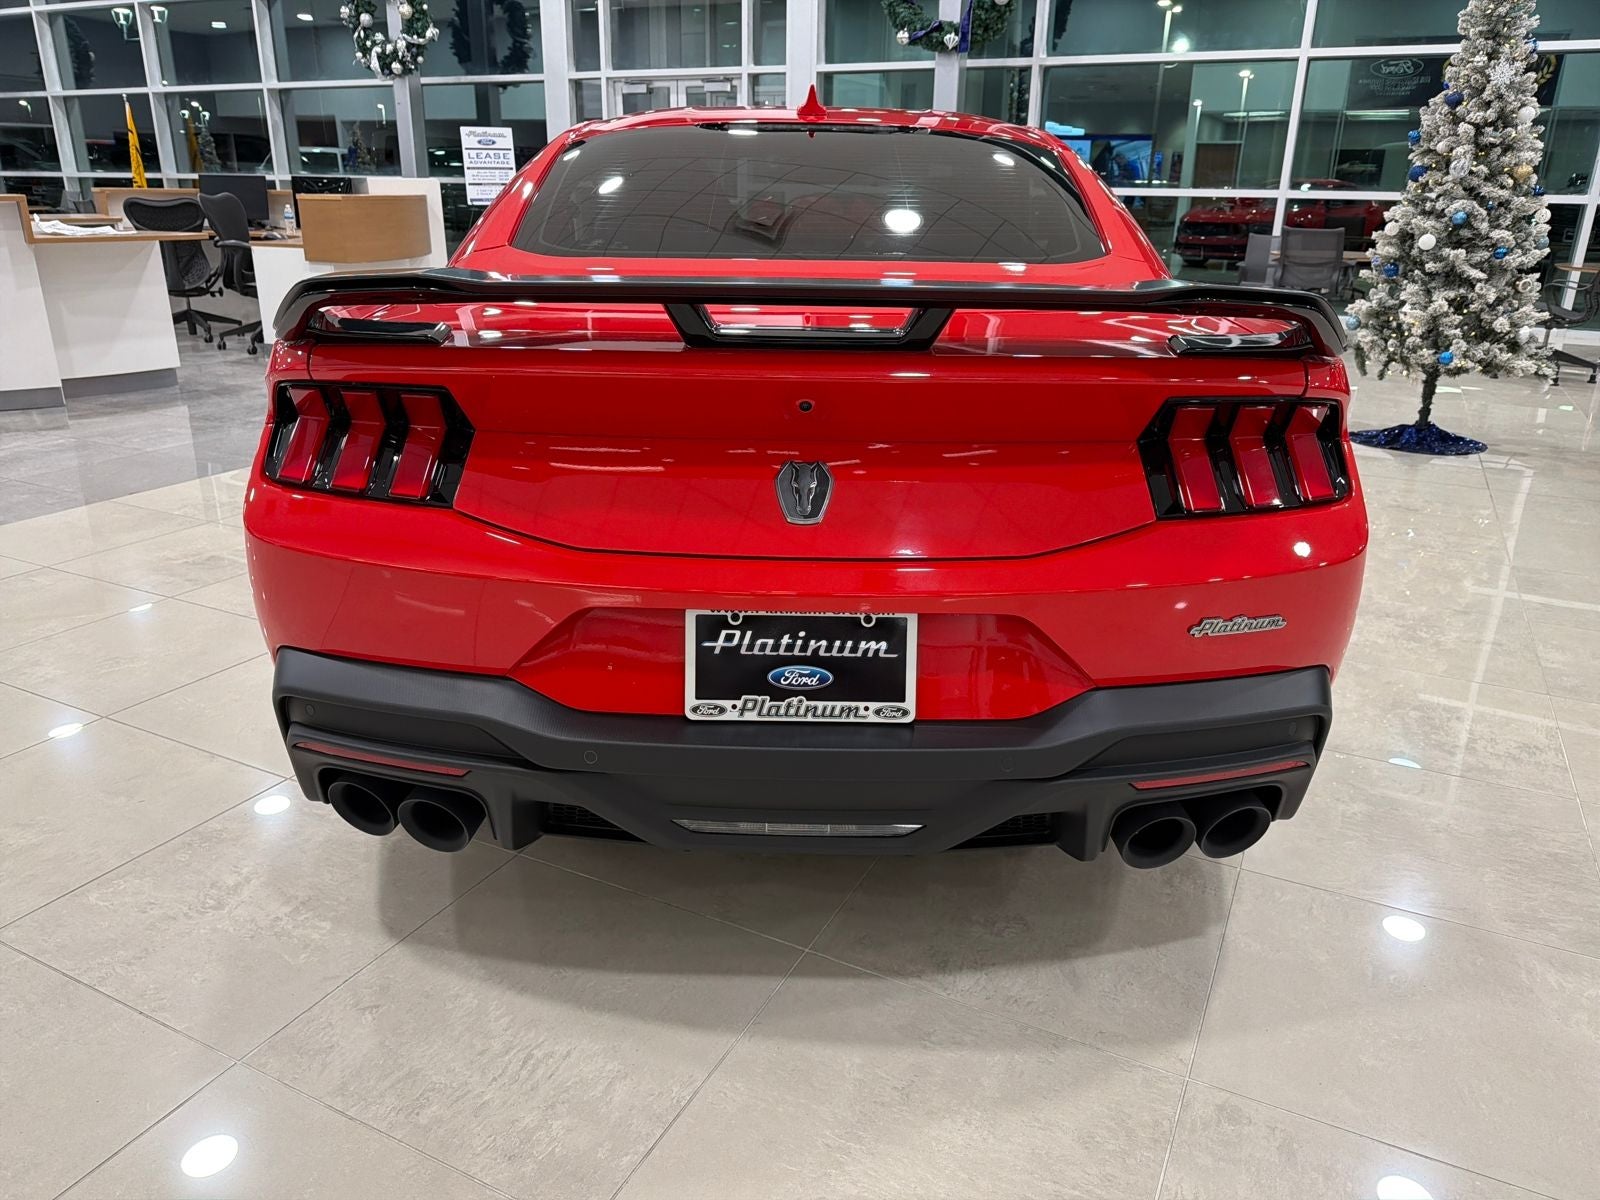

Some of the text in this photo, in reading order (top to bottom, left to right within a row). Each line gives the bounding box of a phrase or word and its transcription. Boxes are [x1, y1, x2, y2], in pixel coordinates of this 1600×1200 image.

[467, 152, 510, 160] LEASE
[1190, 616, 1287, 637] Platinum
[701, 630, 898, 658] Platinum
[780, 669, 820, 686] Ford
[697, 695, 904, 719] Ford Platinum Ford
